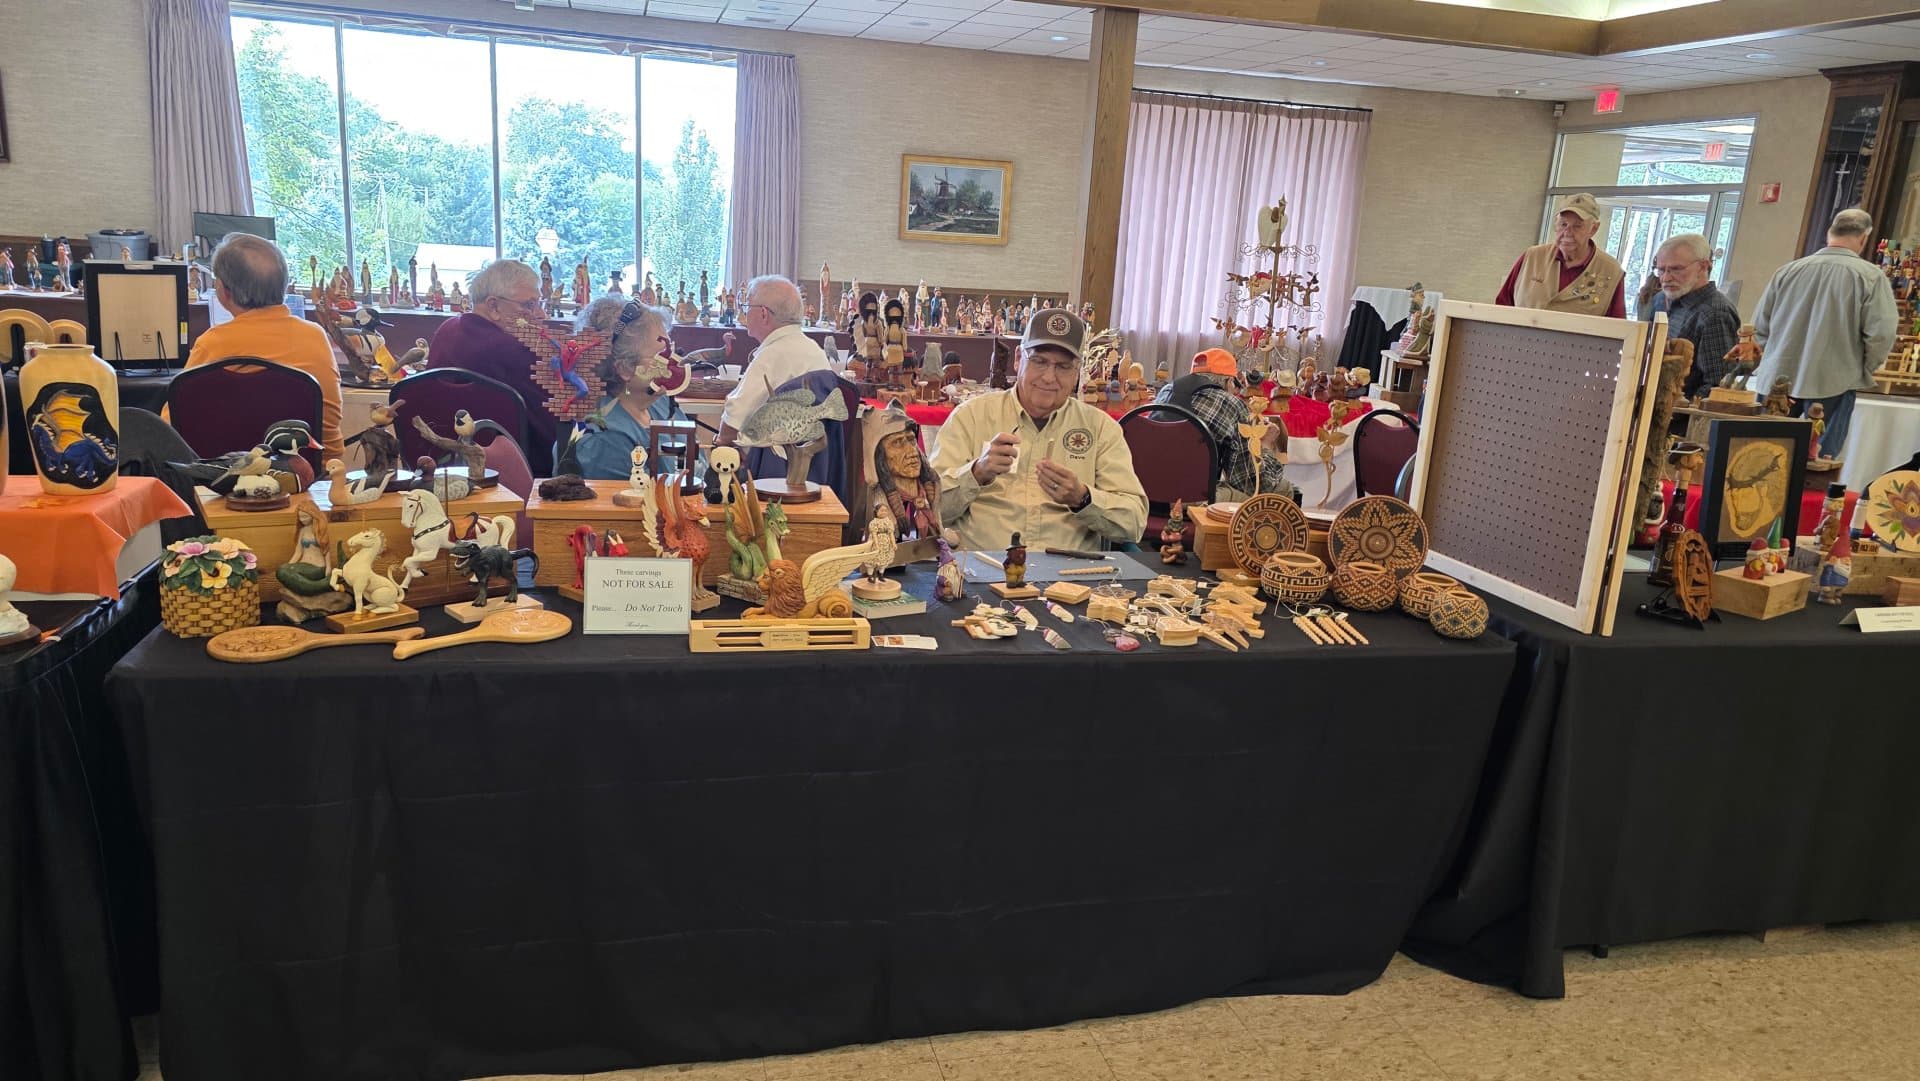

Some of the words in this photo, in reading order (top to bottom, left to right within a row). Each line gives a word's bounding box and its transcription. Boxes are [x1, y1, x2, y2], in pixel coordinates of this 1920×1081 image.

[615, 568, 634, 576] These
[635, 569, 662, 578] carvings
[602, 579, 624, 589] NOT
[626, 579, 646, 589] FOR
[648, 580, 674, 589] SALE
[624, 603, 638, 612] Do
[640, 603, 656, 613] Not
[658, 604, 683, 613] Touch
